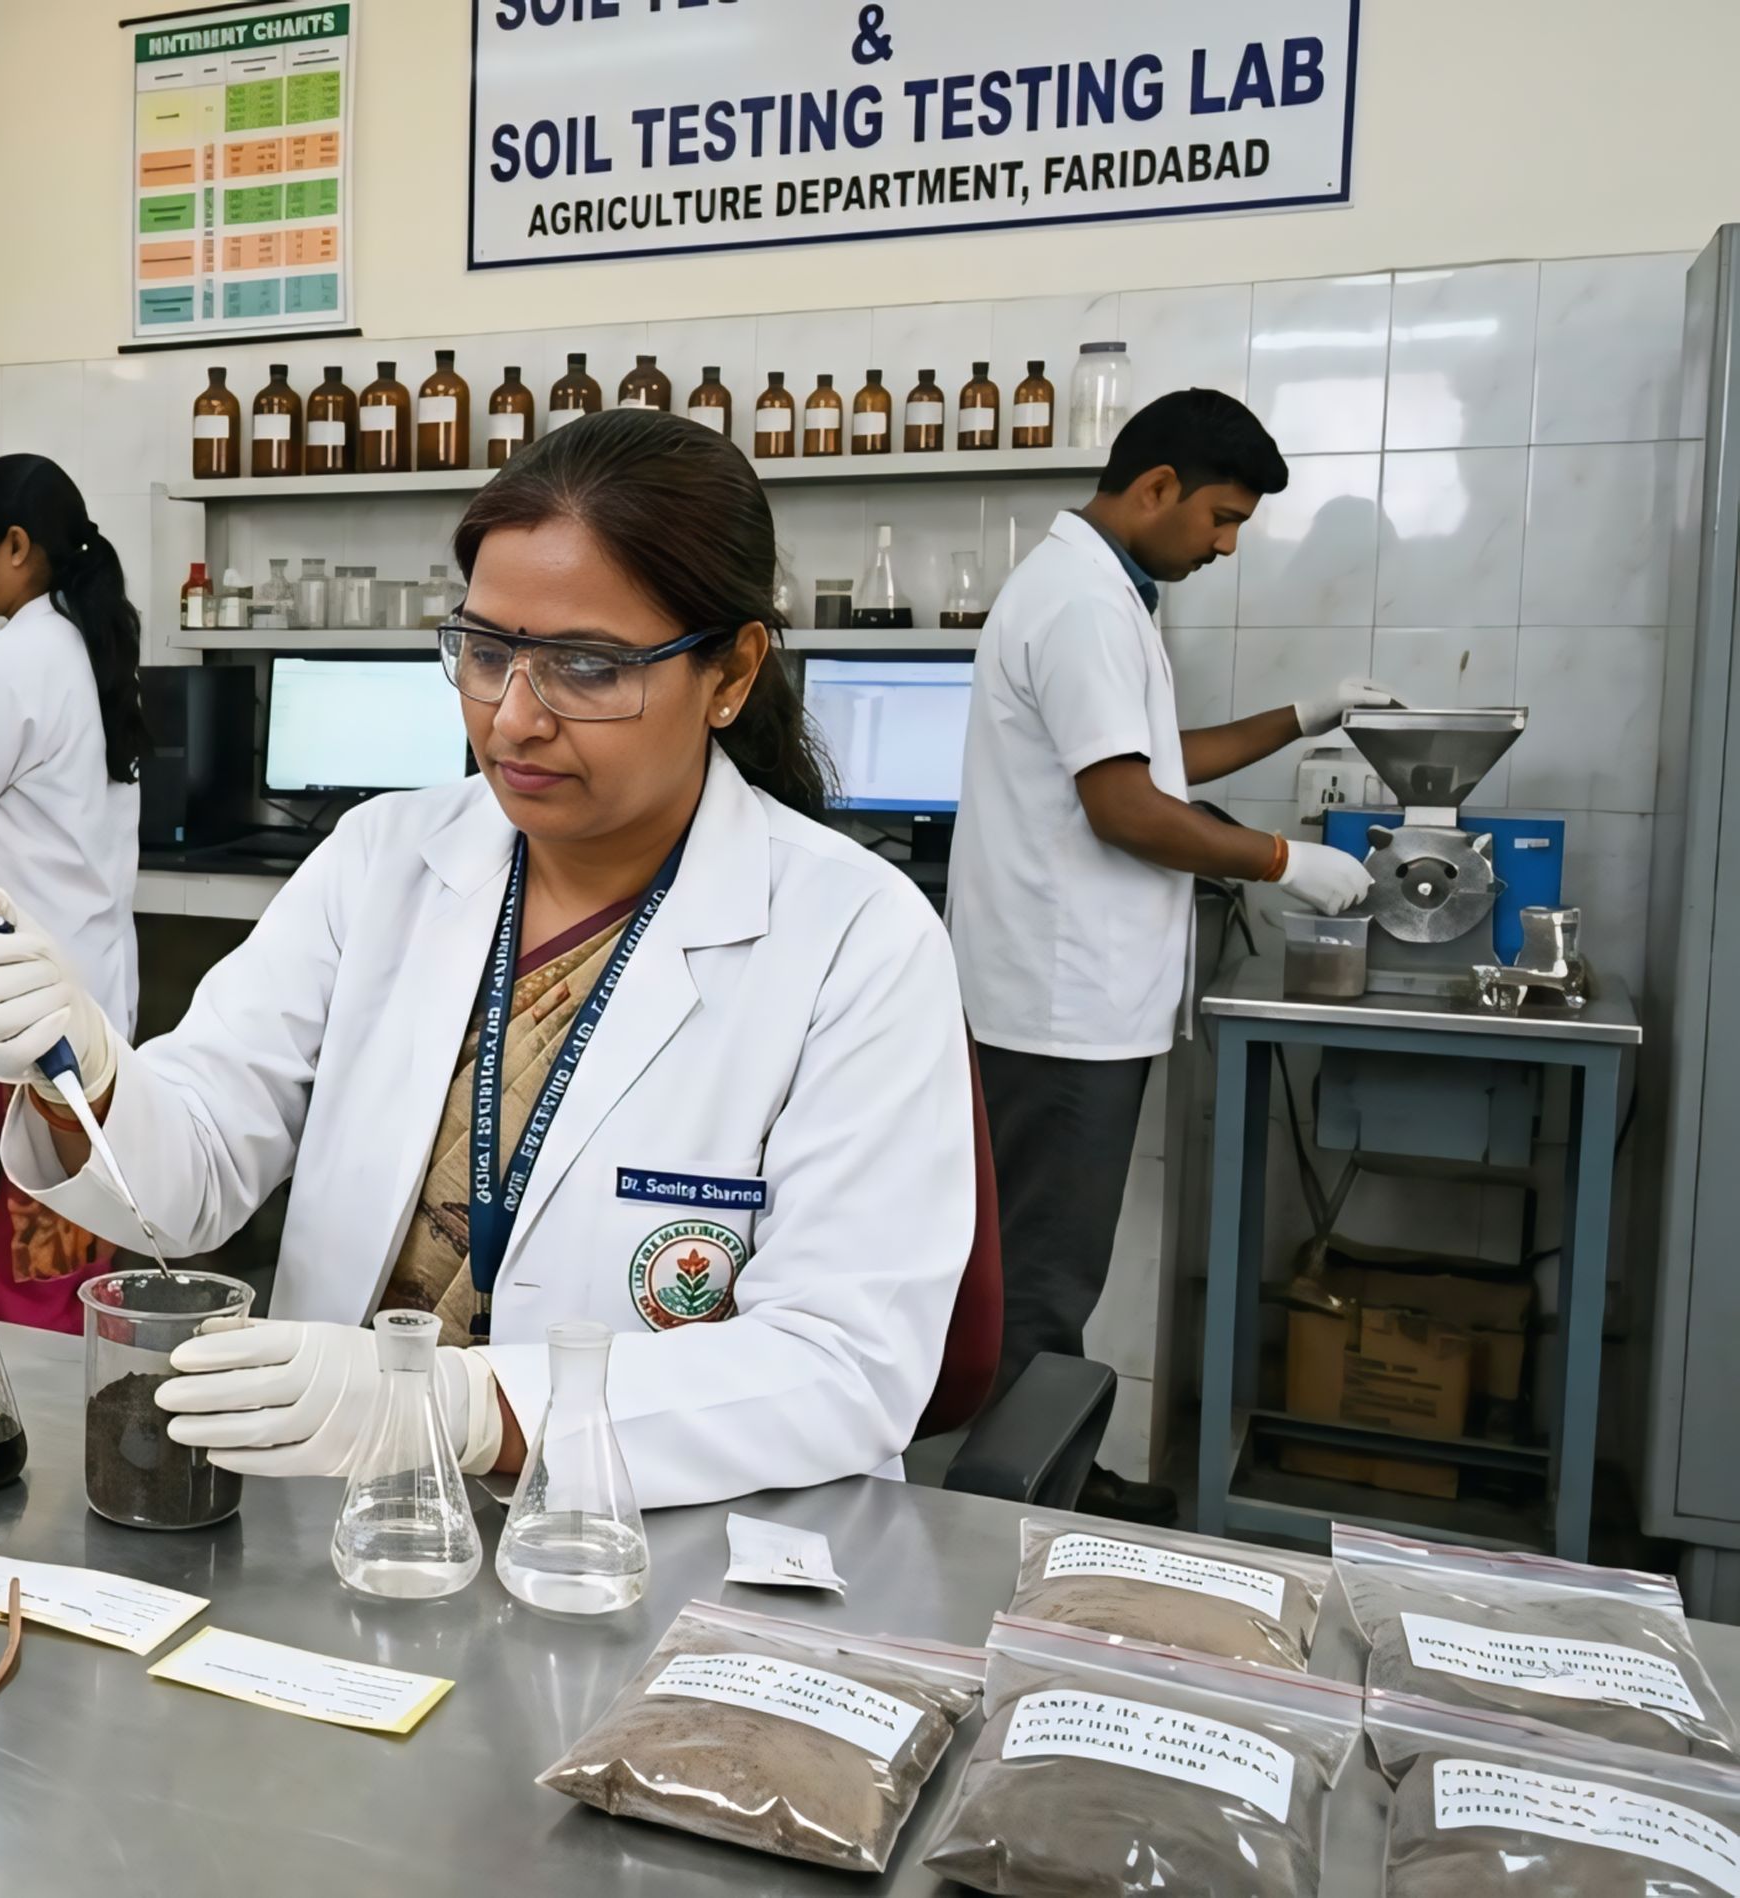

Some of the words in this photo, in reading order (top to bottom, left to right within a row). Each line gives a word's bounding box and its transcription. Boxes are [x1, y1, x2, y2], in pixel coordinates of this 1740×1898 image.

[851, 3, 893, 65] &
[490, 115, 612, 182] SOIL
[632, 84, 883, 168] TESTING
[904, 53, 1163, 142] TESTING
[1190, 36, 1325, 115] LAB
[528, 184, 762, 237] AGRICULTURE
[776, 160, 1029, 216] DEPARTMENT,
[1044, 138, 1270, 194] FARIDABAD
